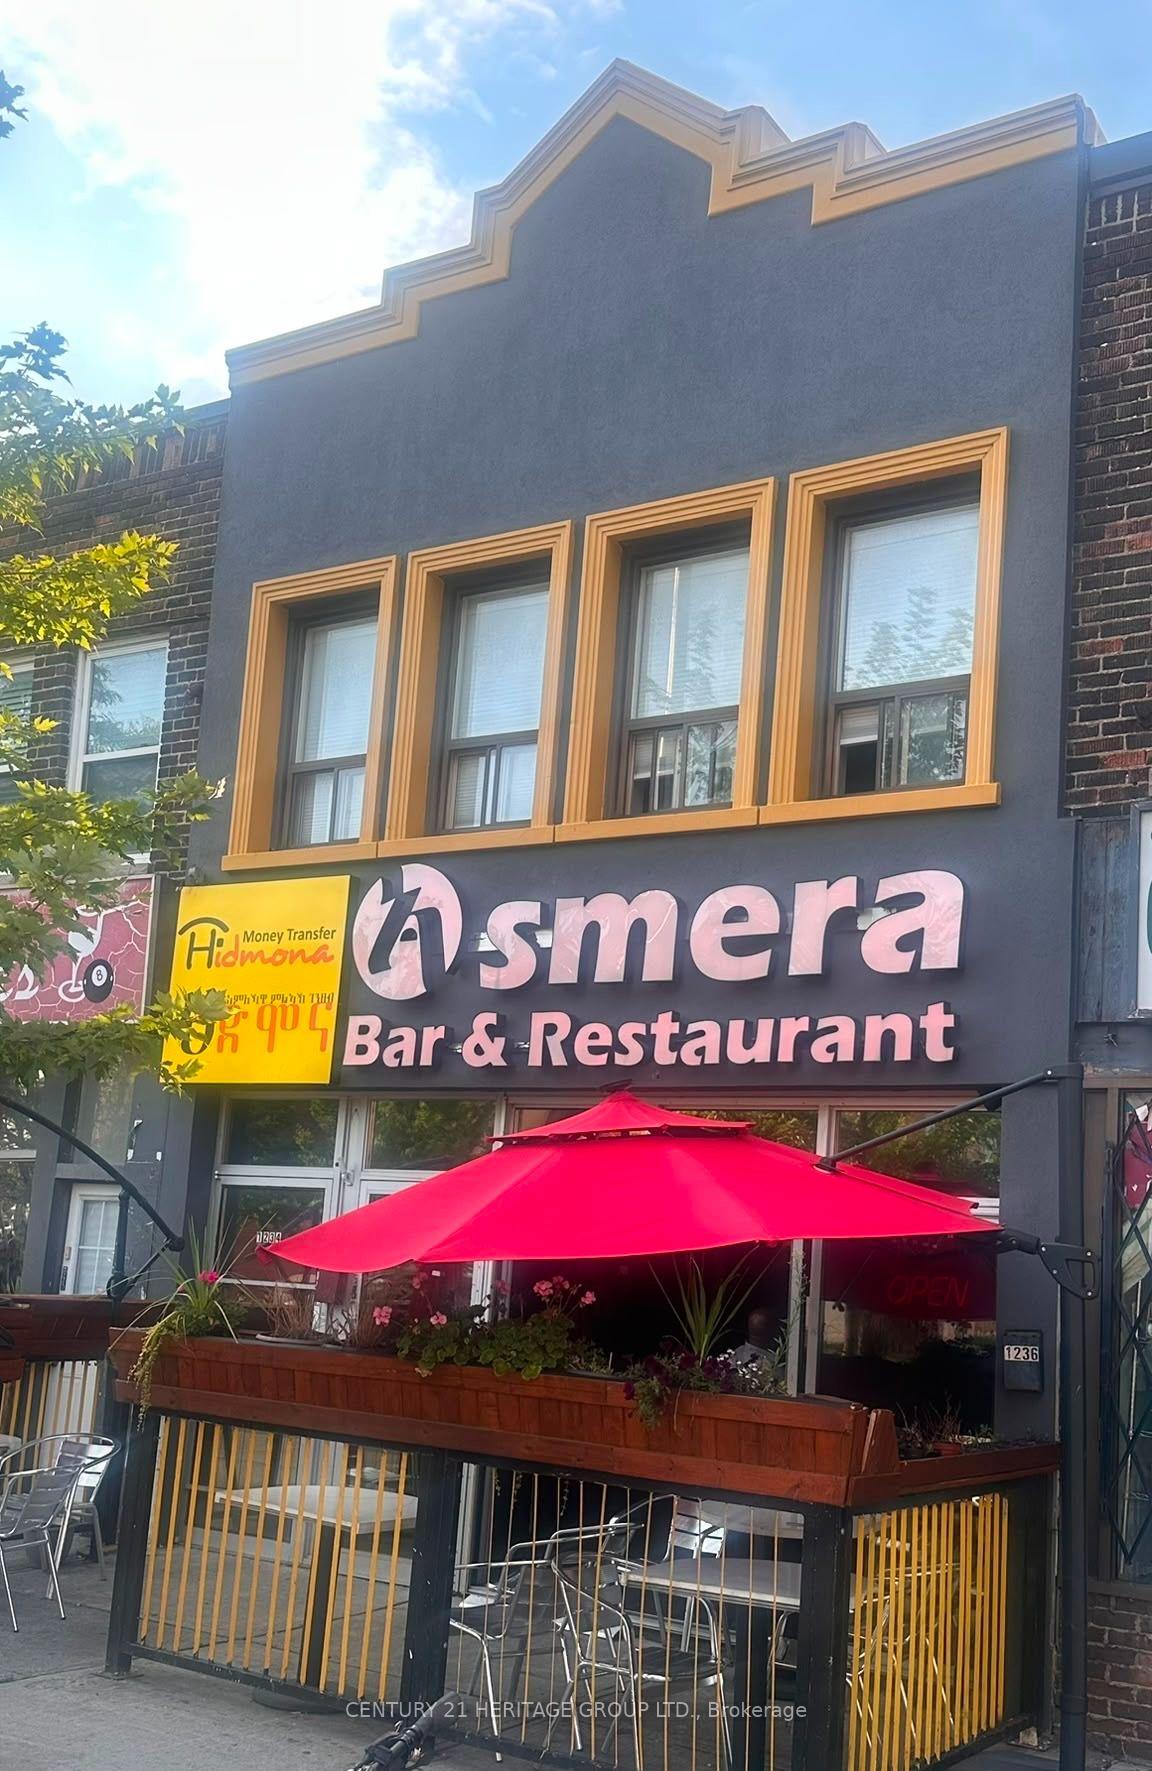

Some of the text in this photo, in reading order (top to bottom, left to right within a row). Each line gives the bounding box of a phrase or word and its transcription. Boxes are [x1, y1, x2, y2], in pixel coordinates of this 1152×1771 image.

[178, 917, 335, 970] Hidmona
[242, 926, 337, 945] Money Transfer
[342, 1002, 957, 1068] Bar & Restaurant
[257, 1231, 281, 1243] 1234
[888, 1275, 969, 1307] OPEN
[1006, 1347, 1038, 1361] 1236
